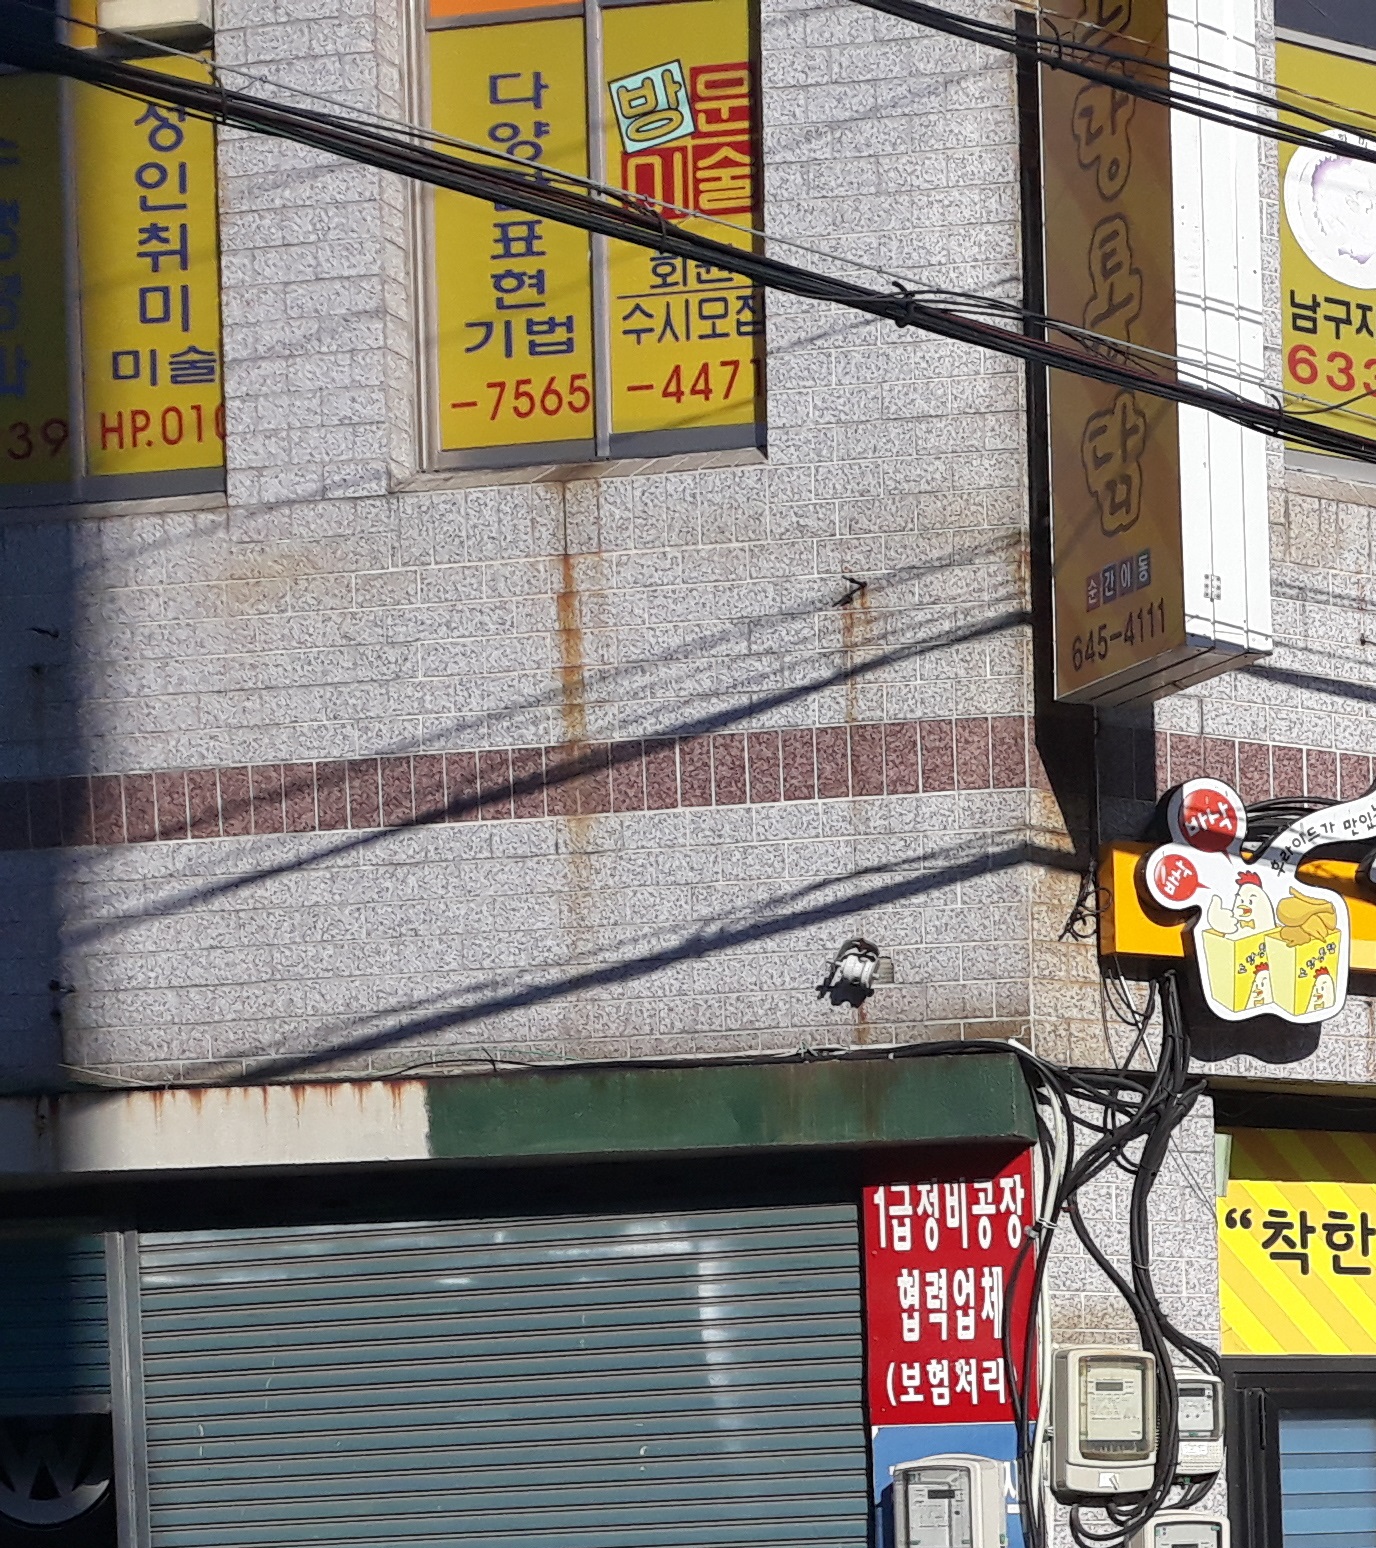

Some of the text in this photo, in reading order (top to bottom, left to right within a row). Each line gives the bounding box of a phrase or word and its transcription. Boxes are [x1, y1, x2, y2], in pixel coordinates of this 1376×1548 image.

[617, 68, 748, 142] 방문
[627, 144, 751, 214] 미술
[135, 102, 189, 333] 성인취미
[490, 220, 546, 311] 표현
[464, 316, 574, 358] 기법
[622, 294, 766, 345] 수시모집
[112, 345, 218, 388] 미술
[451, 374, 591, 421] -7565
[1086, 551, 1151, 612] 순간이동
[1072, 597, 1165, 672] 645-4111
[1184, 799, 1235, 837] 바삭
[1164, 859, 1195, 896] 바삭
[874, 1174, 1026, 1252] 1급정비공장
[897, 1266, 1003, 1342] 협력업체
[886, 1357, 1018, 1408] (보험처리
